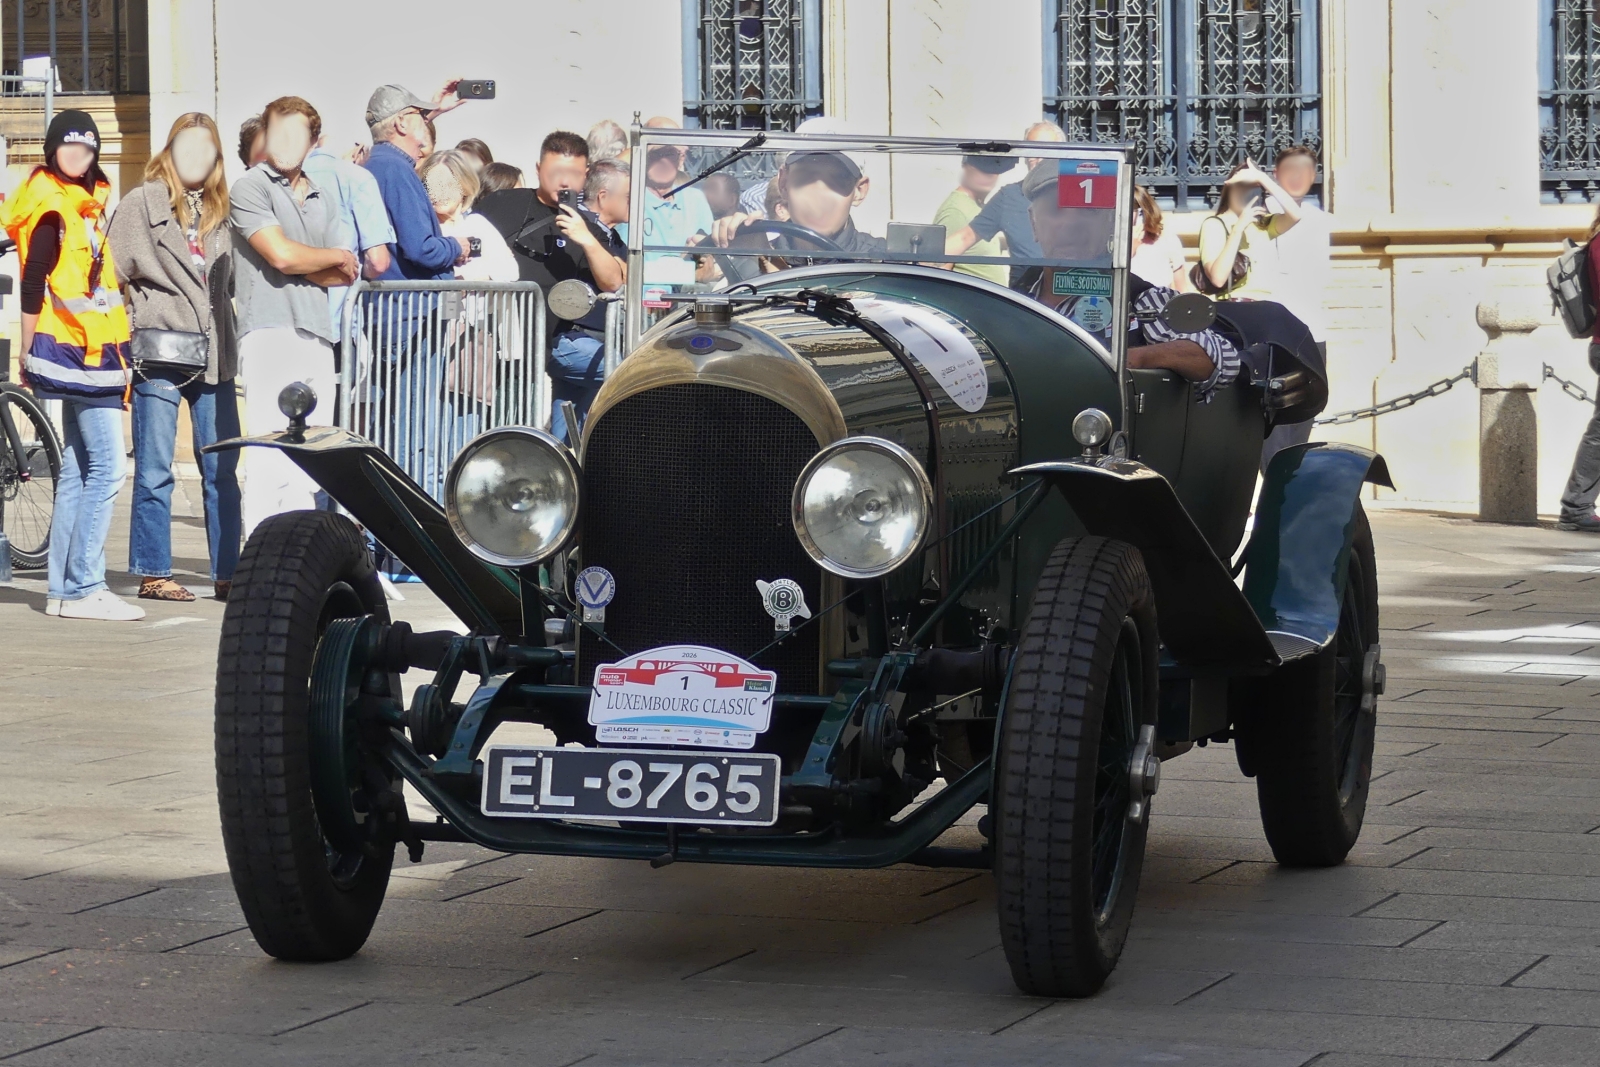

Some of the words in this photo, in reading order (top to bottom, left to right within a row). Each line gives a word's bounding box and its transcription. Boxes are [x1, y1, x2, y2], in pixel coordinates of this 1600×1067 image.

[1079, 179, 1093, 204] 1
[1055, 275, 1075, 289] FLYING
[1077, 276, 1111, 291] SCOTSMAN
[770, 580, 798, 589] BENTLEY
[774, 589, 792, 610] B
[765, 604, 788, 619] DRIVERS
[789, 605, 802, 618] CLUB
[680, 676, 689, 690] 1
[607, 691, 699, 712] LUXEMBOURG
[702, 698, 758, 716] CLASSIC
